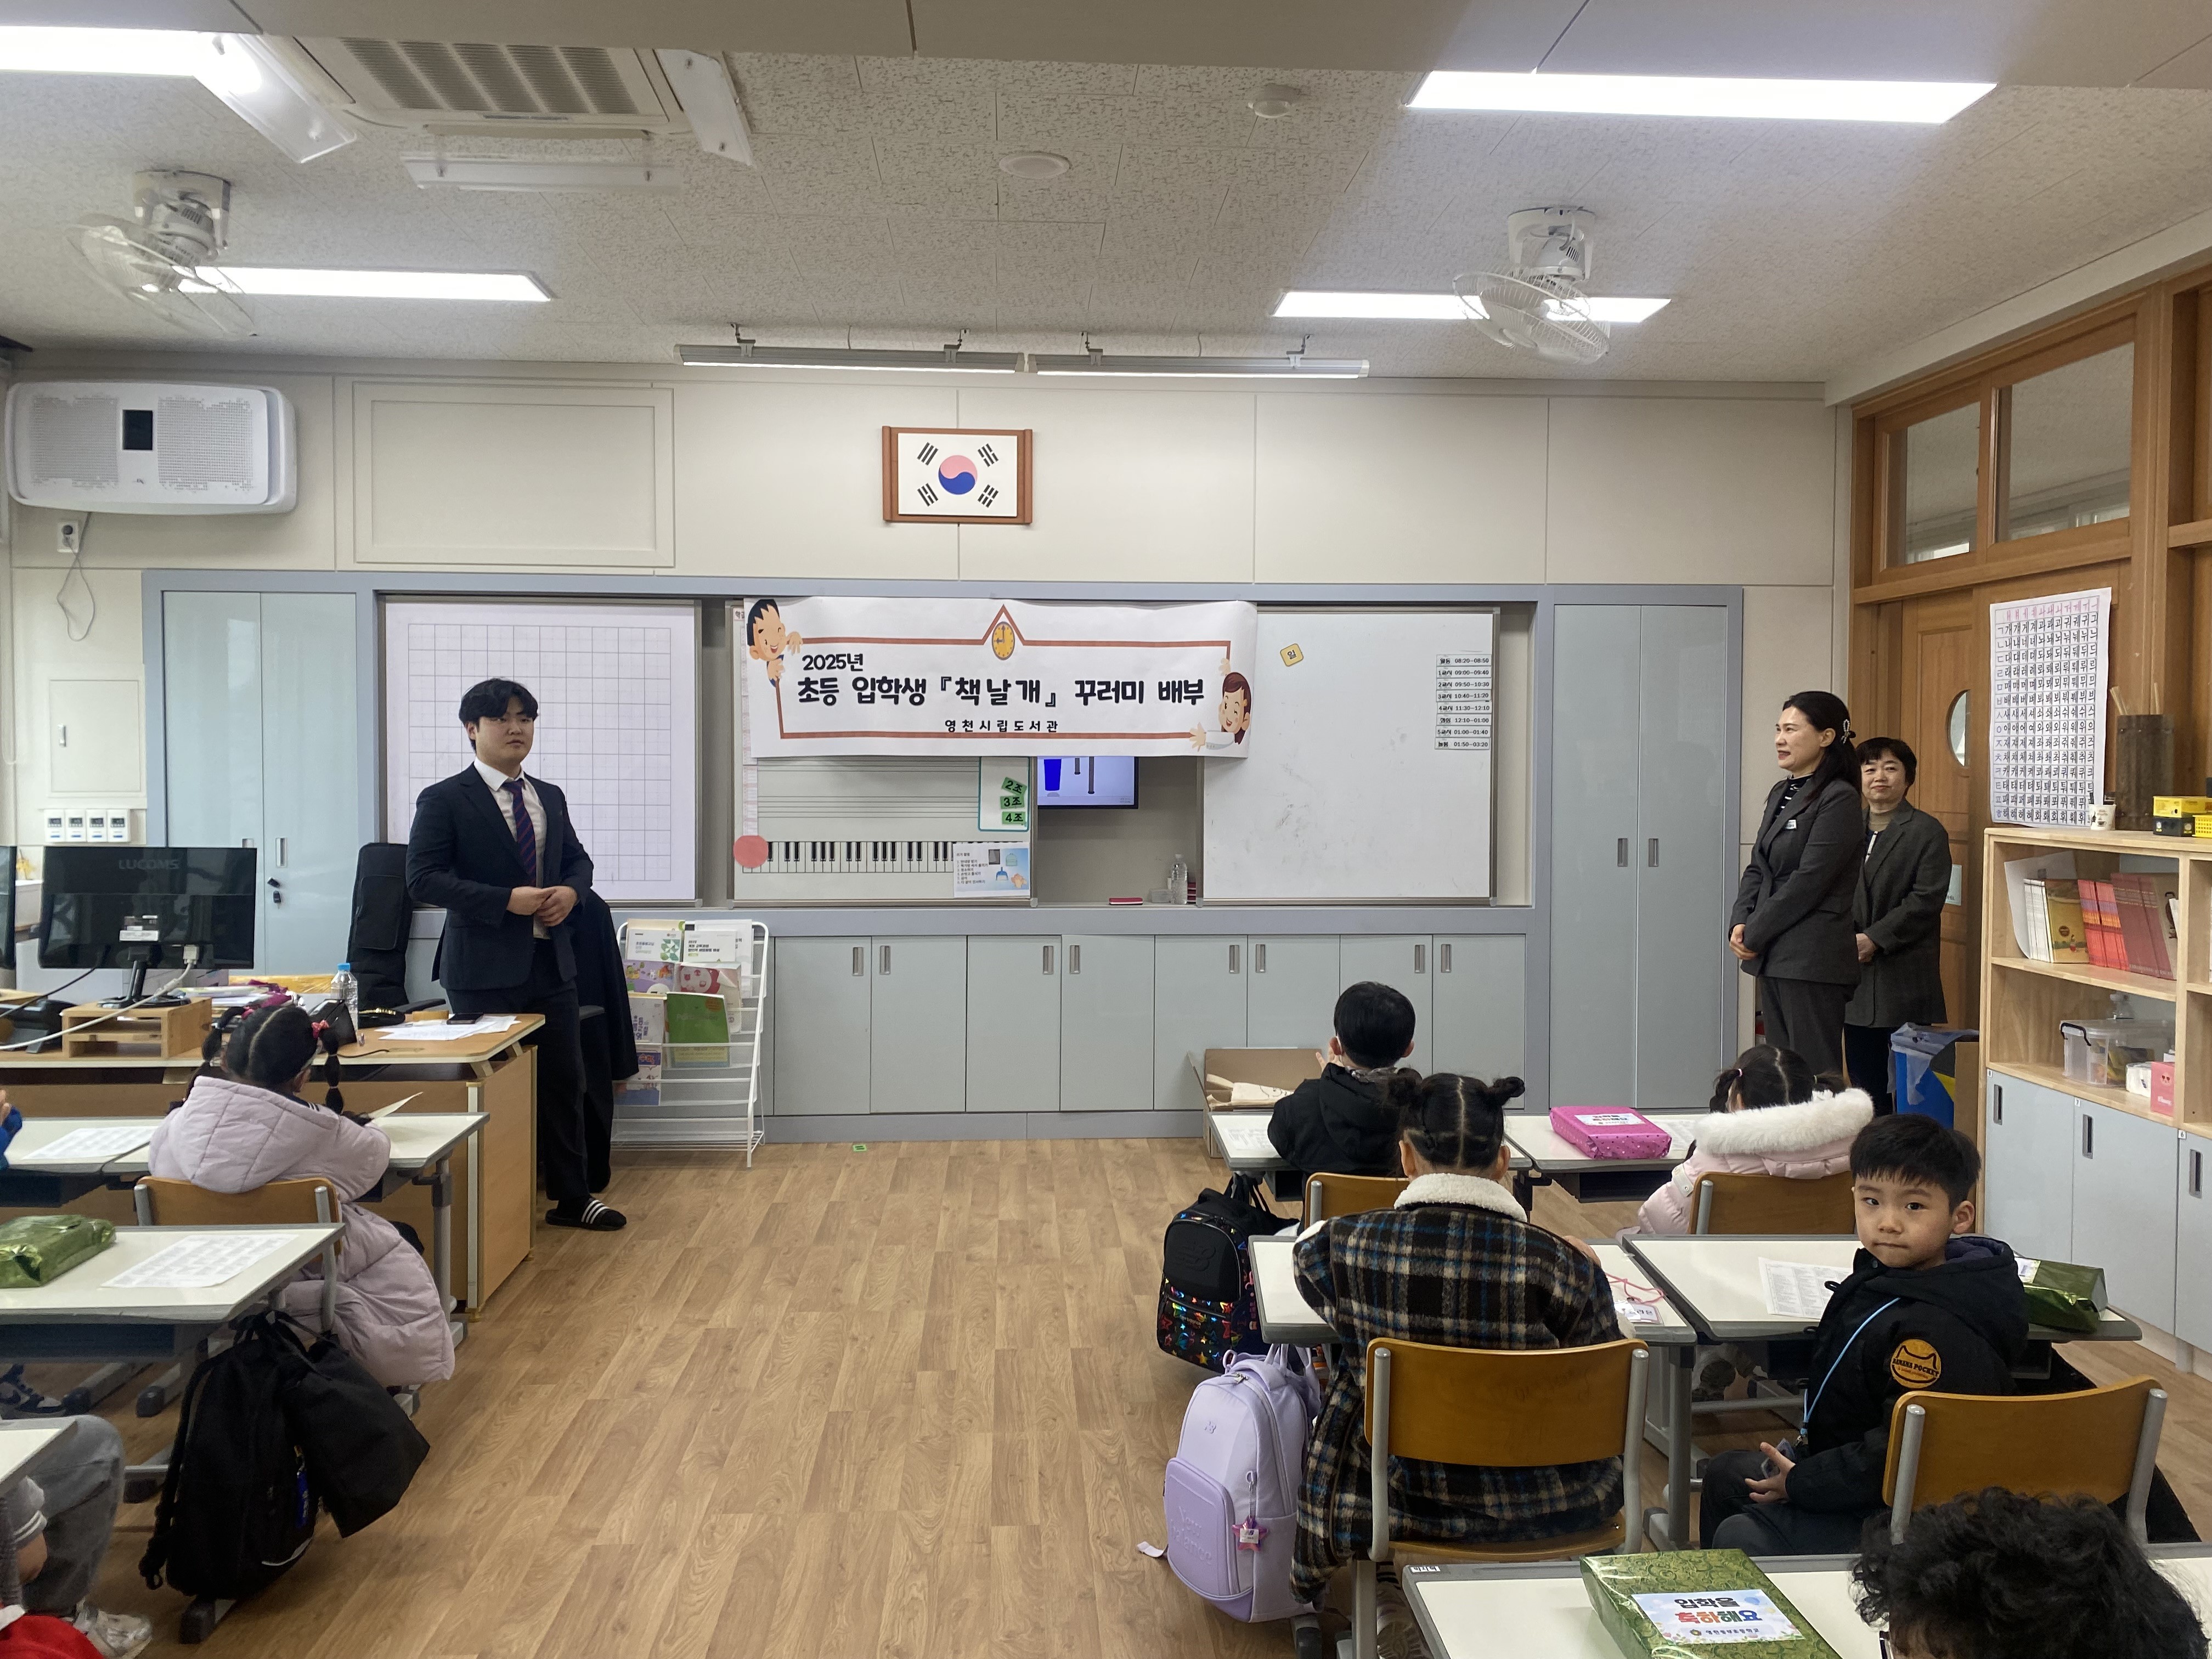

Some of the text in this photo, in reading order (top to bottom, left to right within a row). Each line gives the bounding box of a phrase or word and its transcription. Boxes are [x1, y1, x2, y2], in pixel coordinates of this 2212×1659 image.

[802, 653, 864, 672] 2025년
[797, 676, 1204, 708] 초등 입학생 『책날개』 꾸러미 배부
[944, 719, 1059, 733] 영천시립도서관
[1005, 780, 1023, 794] 2조
[1003, 797, 1022, 807] 3조
[1005, 813, 1024, 822] 4조
[1674, 1598, 1740, 1609] 입학을
[1675, 1610, 1763, 1624] 축하해요
